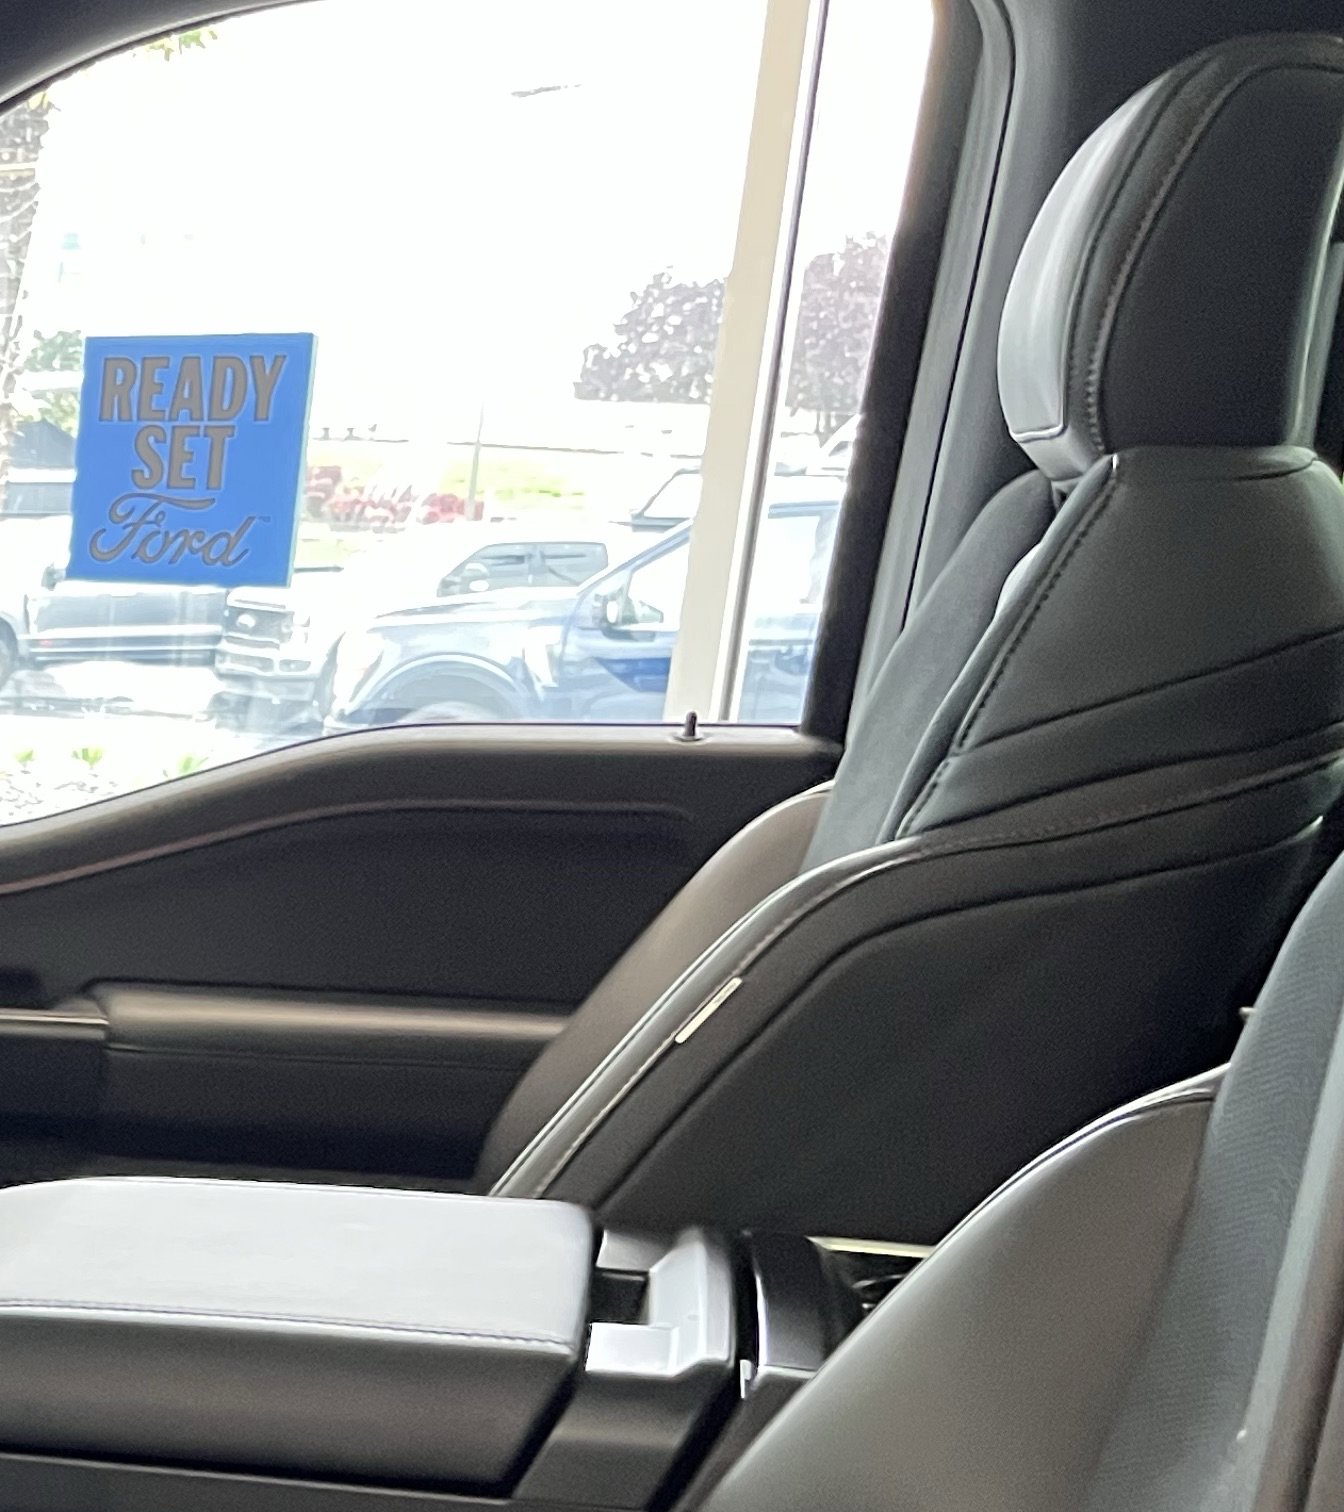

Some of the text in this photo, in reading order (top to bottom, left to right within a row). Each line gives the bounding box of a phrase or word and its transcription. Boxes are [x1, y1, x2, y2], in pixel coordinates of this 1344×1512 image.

[98, 355, 287, 422] READY
[131, 424, 235, 490] SET
[89, 492, 256, 567] Ford
